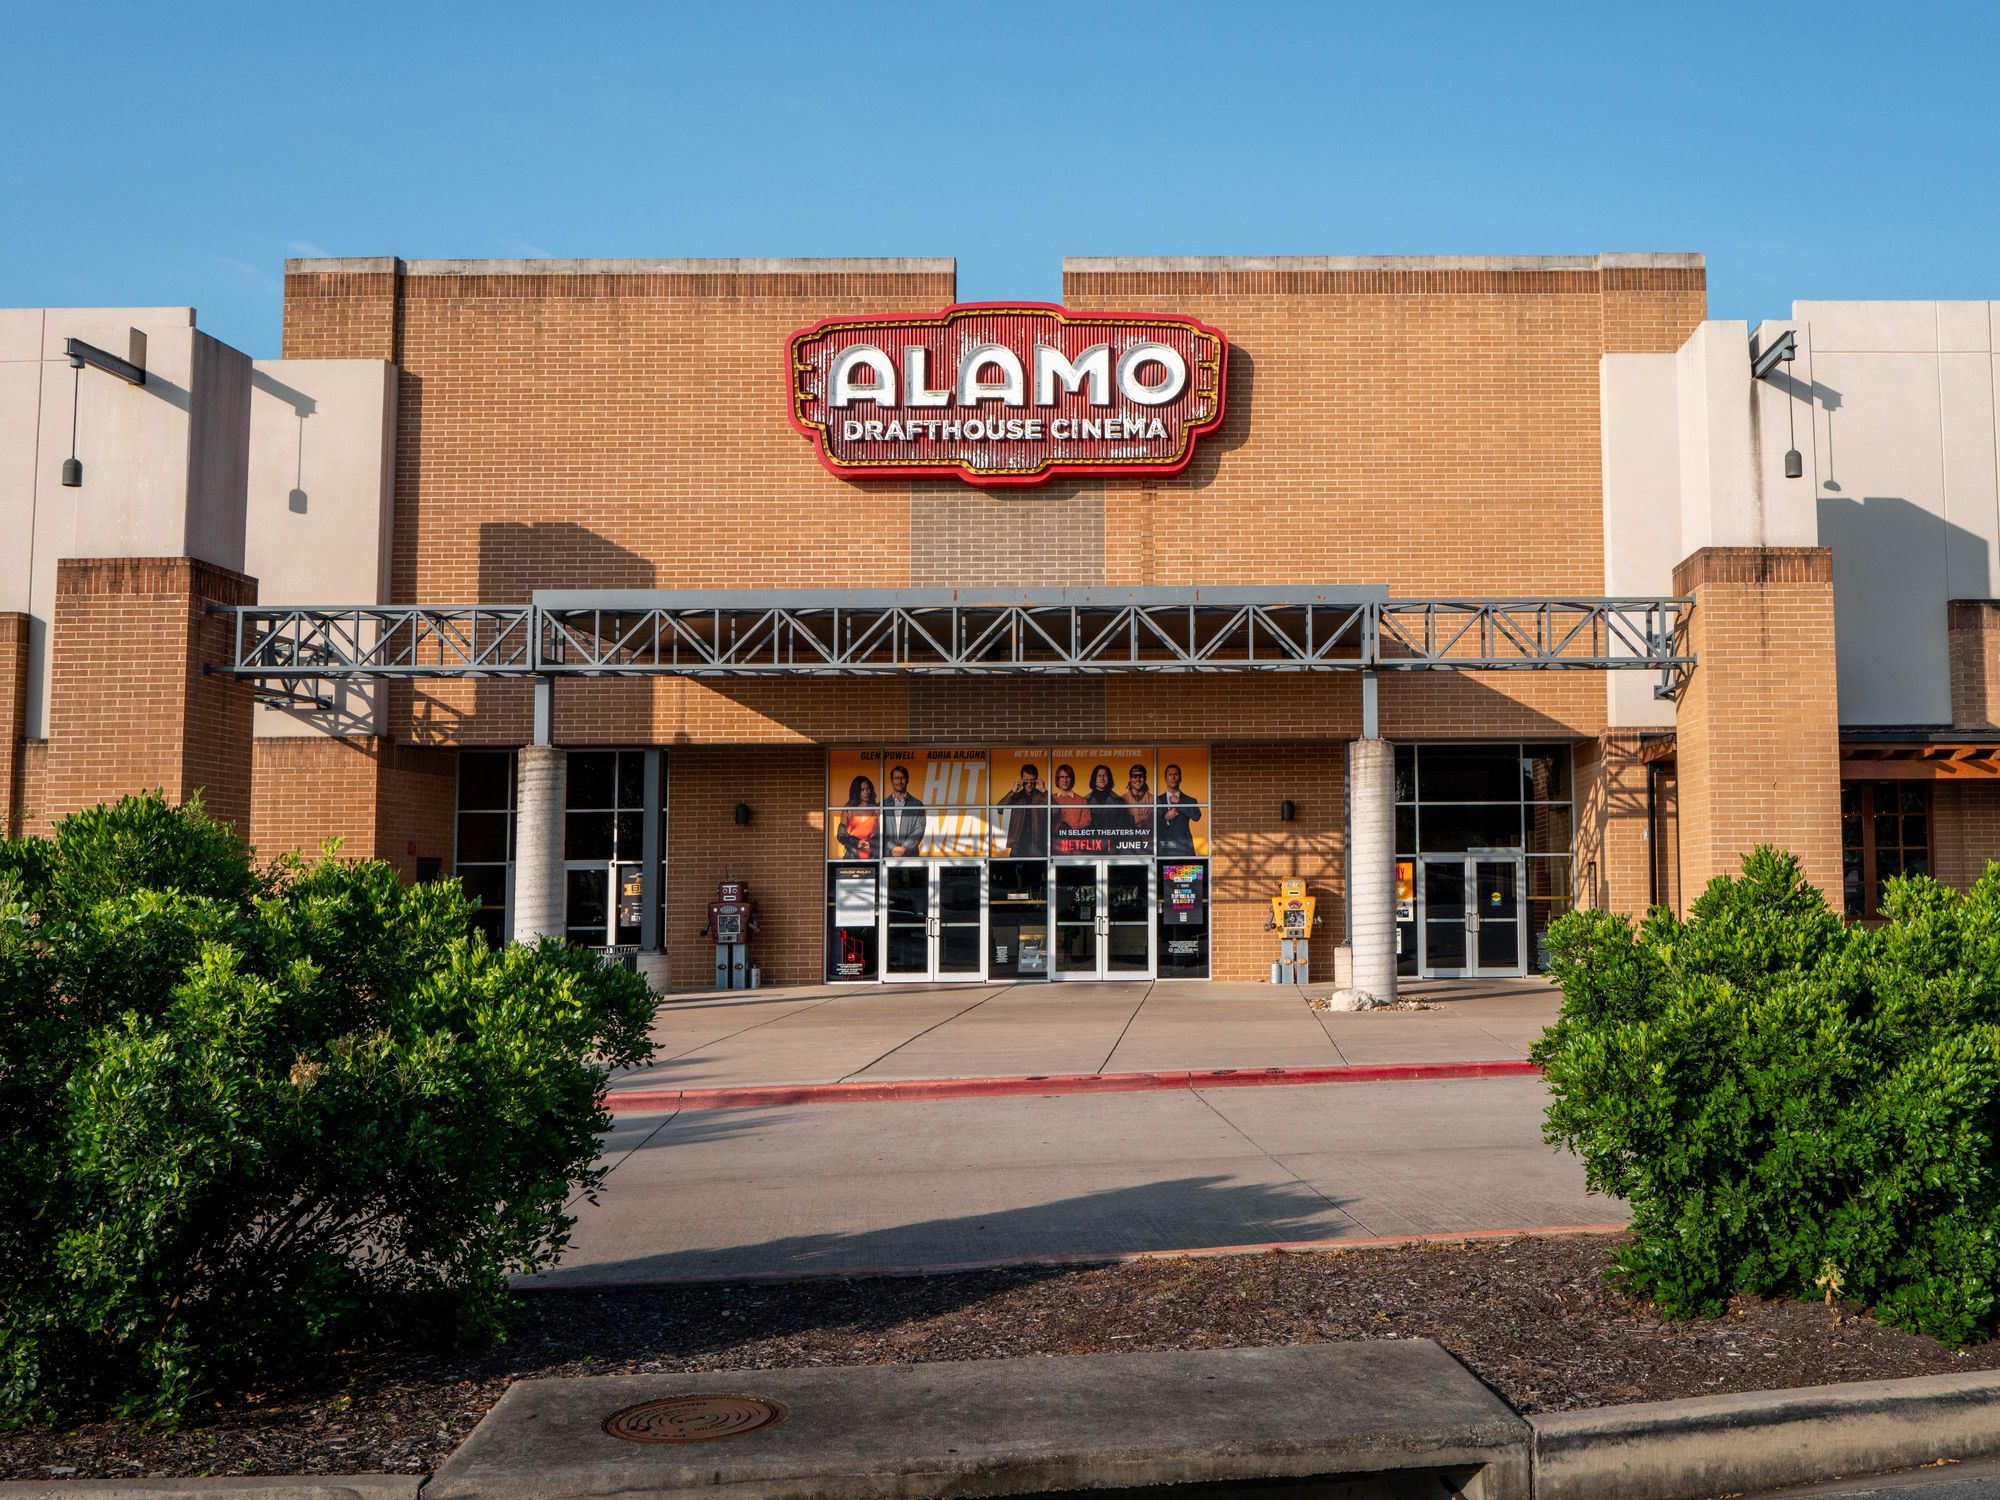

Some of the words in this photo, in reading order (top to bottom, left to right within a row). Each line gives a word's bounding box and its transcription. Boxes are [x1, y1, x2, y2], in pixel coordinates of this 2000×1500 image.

[828, 342, 1187, 407] ALAMO
[844, 418, 1043, 441] DRAFTHOUSE
[1051, 417, 1169, 440] CINEMA
[860, 751, 880, 760] GLEN
[884, 751, 915, 760] POWELL
[927, 750, 951, 760] ADRIA
[954, 750, 985, 759] ARJONA
[923, 762, 986, 807] HIT
[919, 808, 1011, 852] MAN
[1061, 839, 1102, 851] NETFLIX
[1116, 841, 1141, 849] JUNE
[1143, 841, 1148, 849] 7
